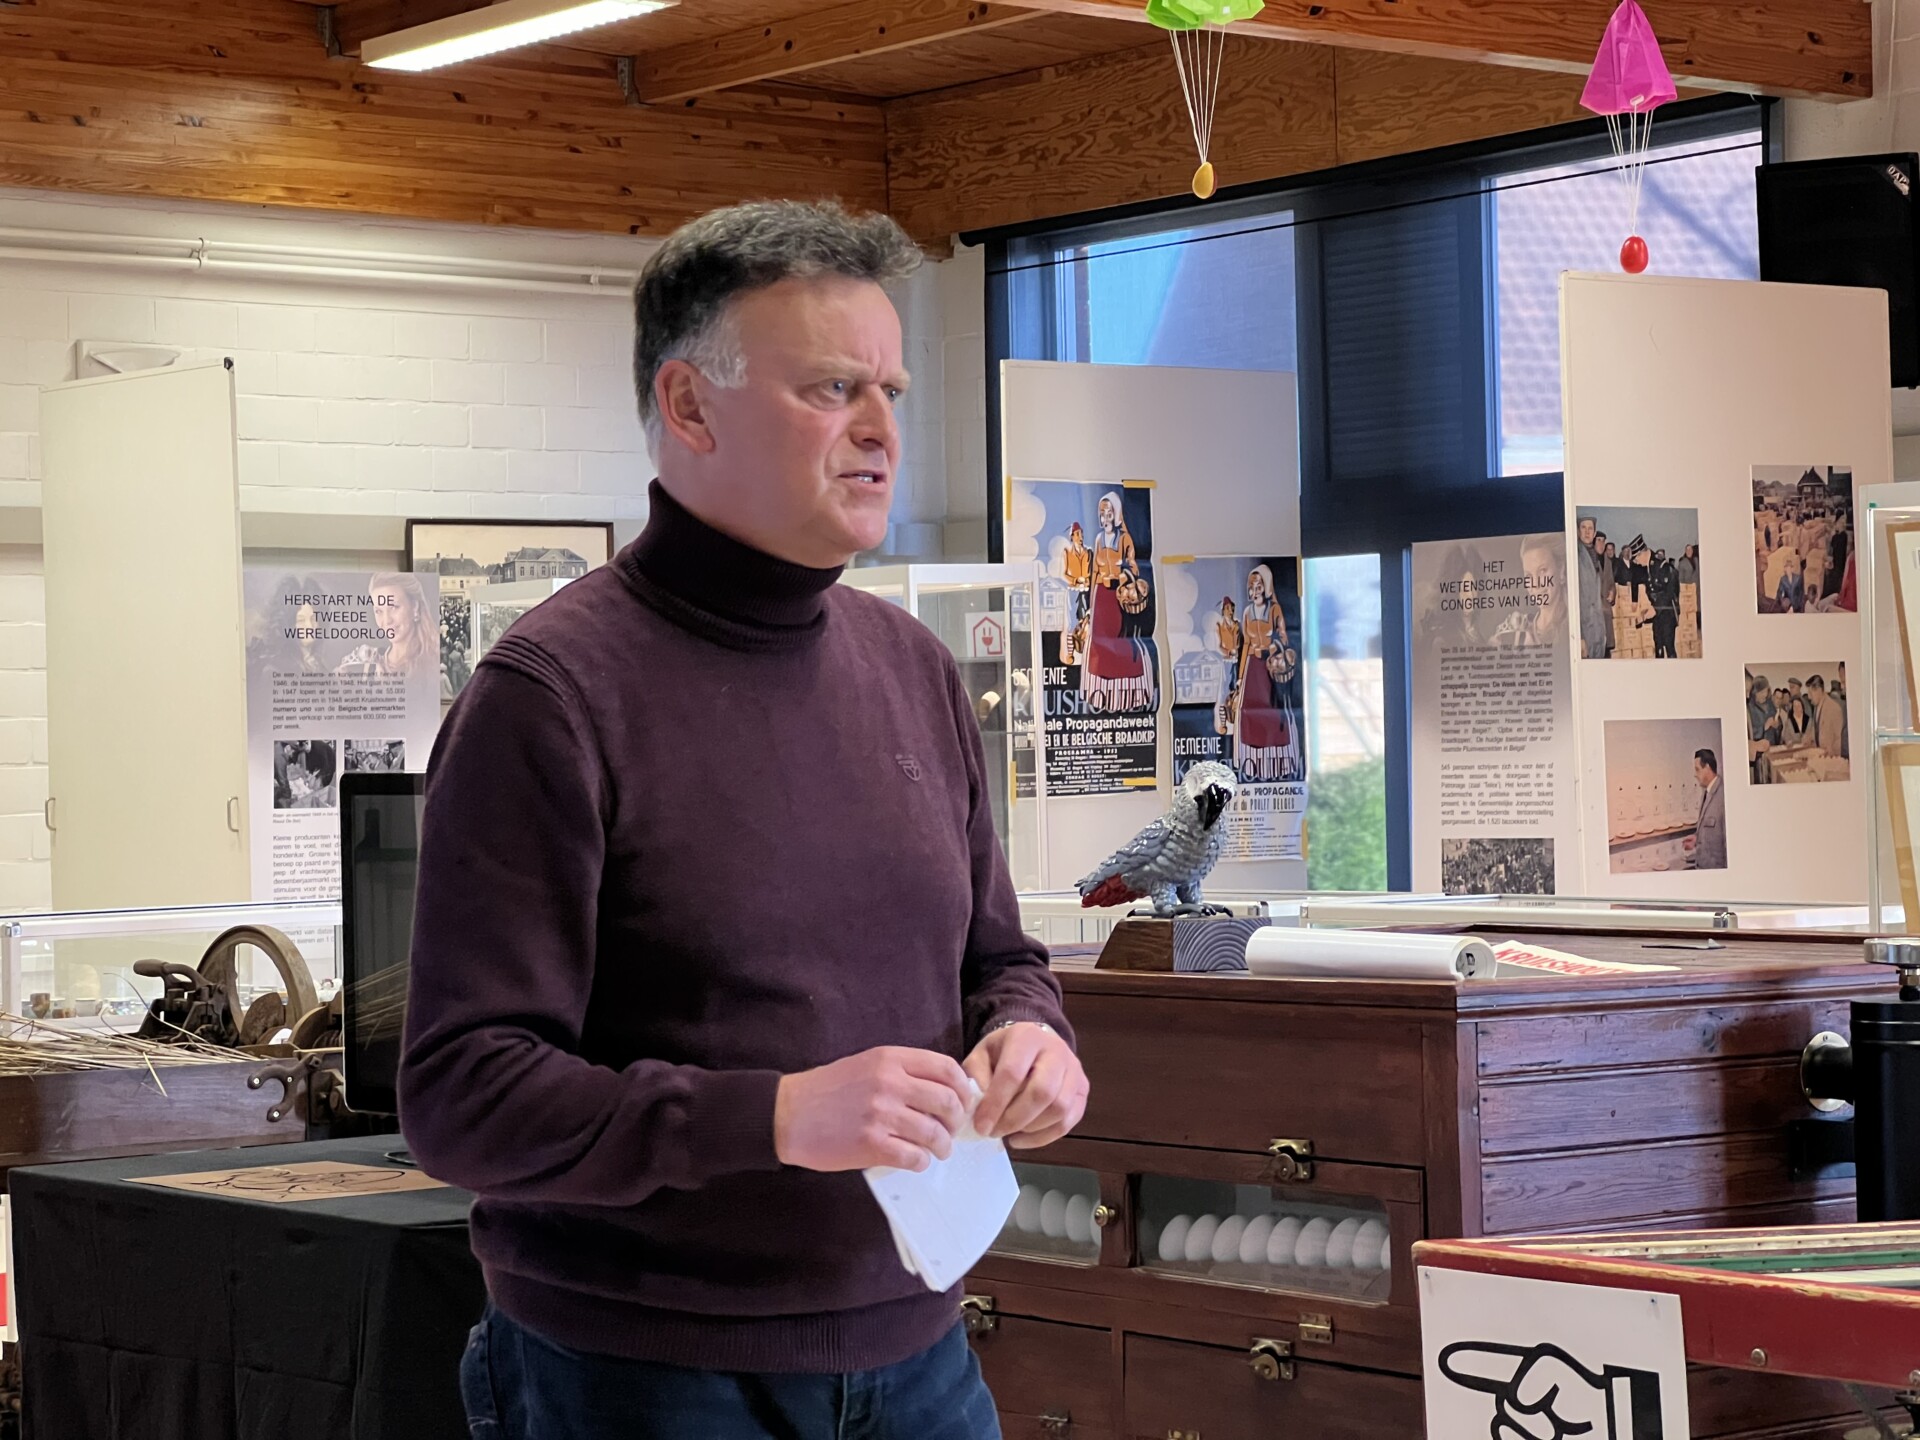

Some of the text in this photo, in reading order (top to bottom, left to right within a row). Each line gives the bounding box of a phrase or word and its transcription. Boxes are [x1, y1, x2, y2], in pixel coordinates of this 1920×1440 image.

[1483, 561, 1505, 573] HET
[1440, 576, 1555, 594] WETENSCHAPPELIJK
[284, 594, 395, 606] HERSTART NA DE
[1441, 594, 1550, 611] CONGRES VAN 1952
[313, 611, 368, 623] TWEEDE
[284, 628, 395, 639] WERELDOORLOG
[1065, 715, 1155, 732] Propagandaweek
[1071, 732, 1113, 746] BELGISCHE
[1115, 730, 1155, 744] BRAADKIP
[1174, 737, 1222, 756] GEMEENTE
[1254, 786, 1304, 796] PROPAGANDE
